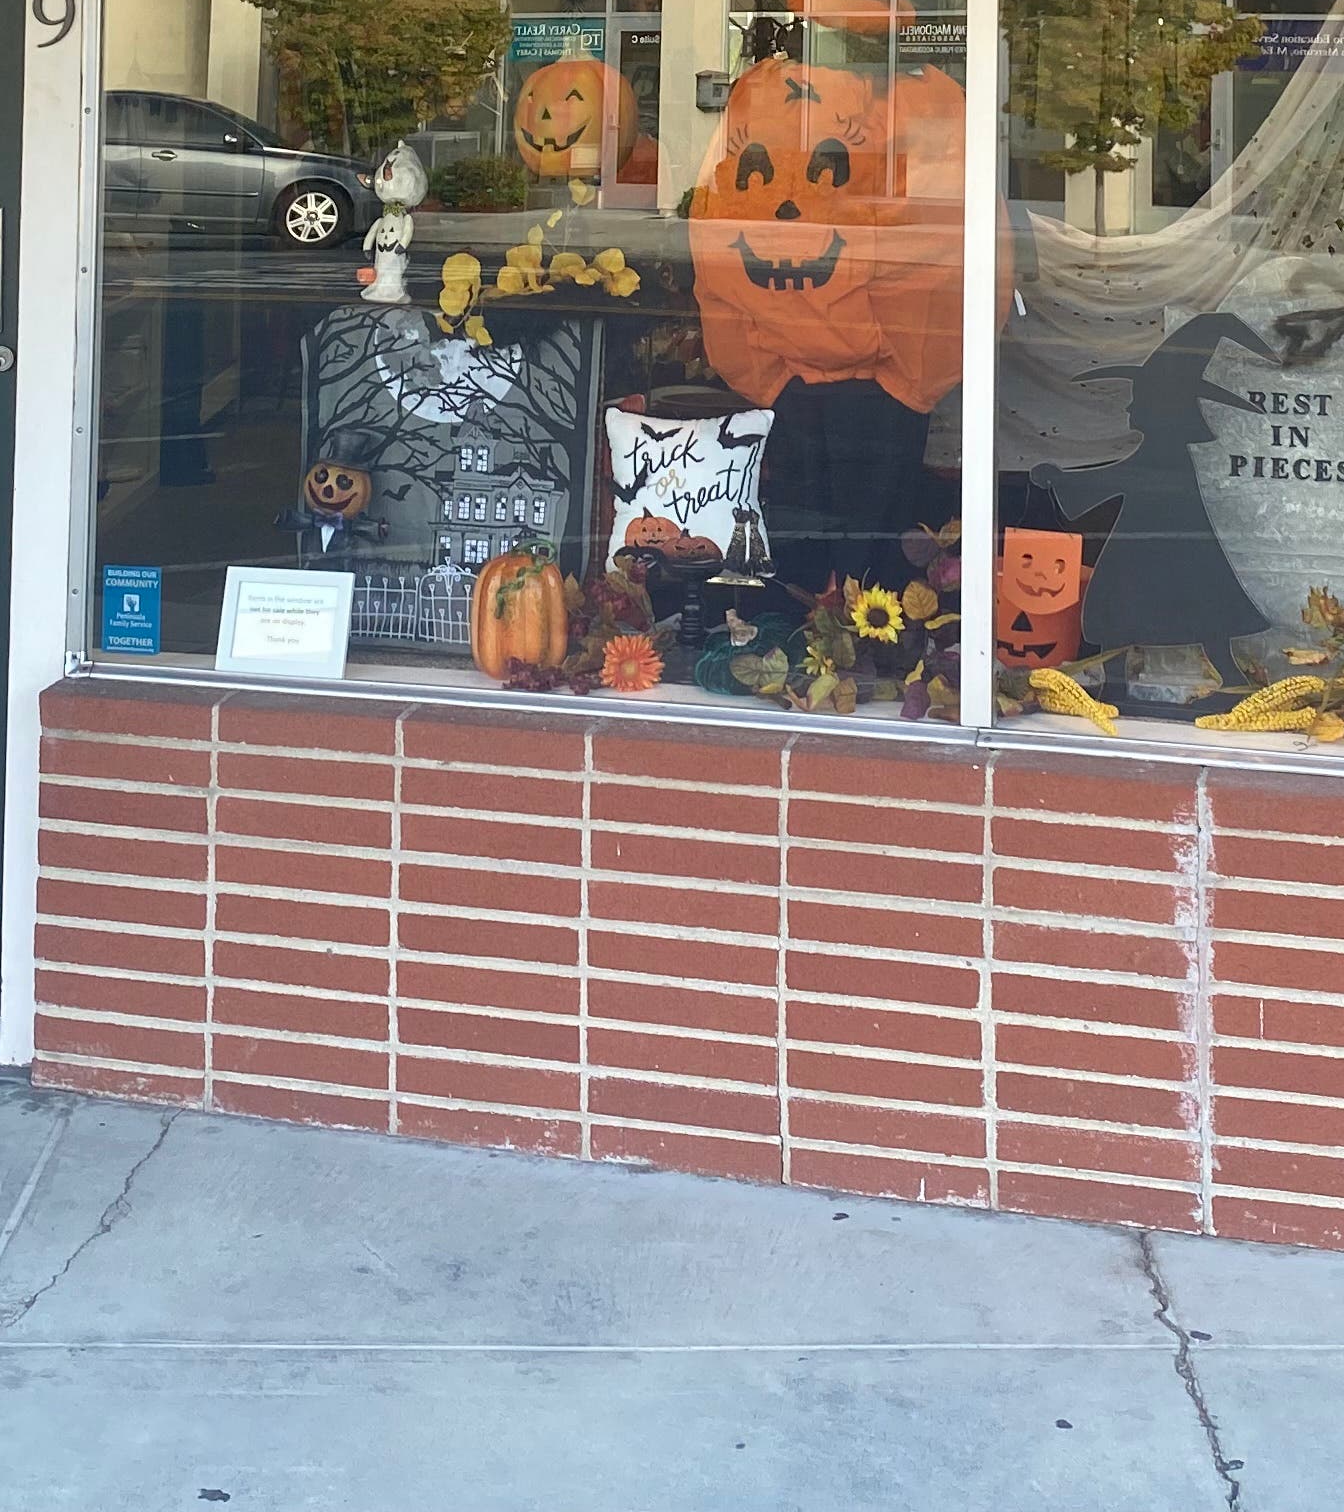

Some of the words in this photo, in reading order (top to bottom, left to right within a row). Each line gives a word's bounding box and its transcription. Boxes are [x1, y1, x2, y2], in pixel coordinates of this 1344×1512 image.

[1247, 390, 1332, 416] REST
[1270, 424, 1310, 448] IN
[624, 430, 705, 479] trick
[649, 468, 686, 498] or
[664, 460, 741, 525] treat
[105, 577, 159, 589] COMMUNITY
[107, 569, 140, 578] BUILDING
[141, 570, 158, 578] OUR
[108, 636, 153, 647] TOGETHER
